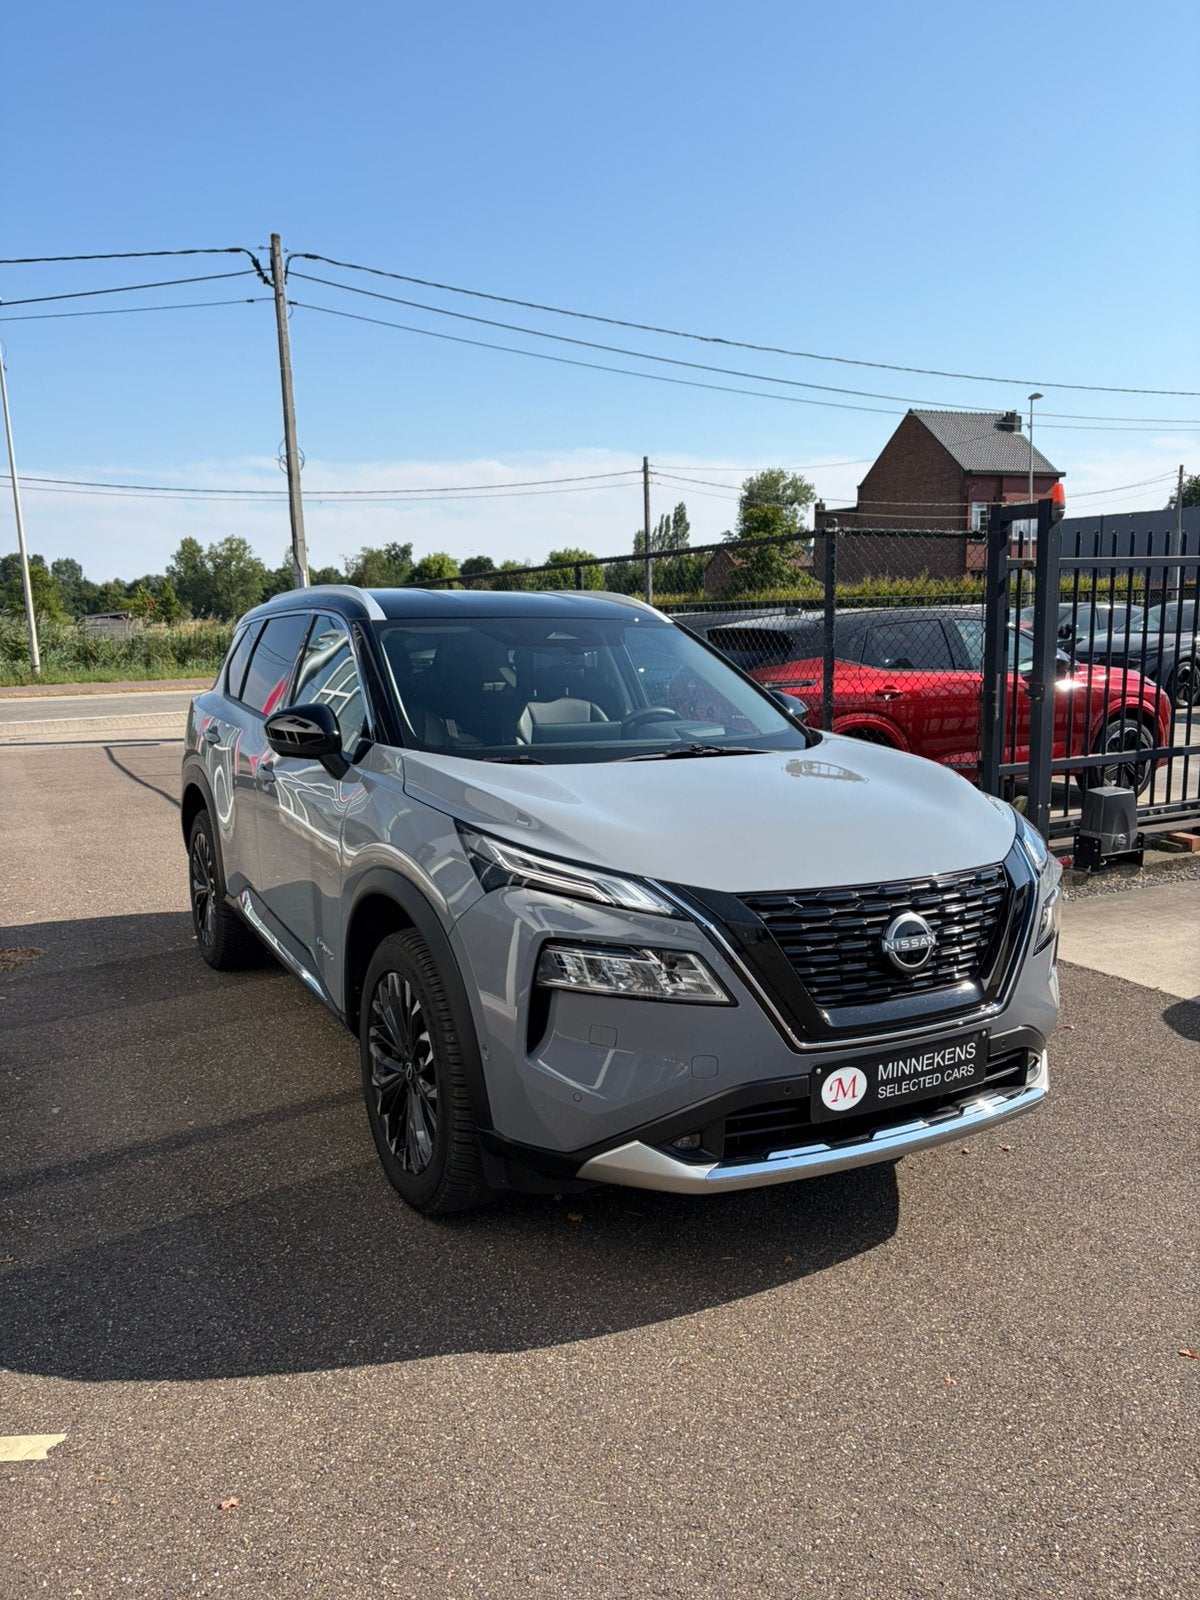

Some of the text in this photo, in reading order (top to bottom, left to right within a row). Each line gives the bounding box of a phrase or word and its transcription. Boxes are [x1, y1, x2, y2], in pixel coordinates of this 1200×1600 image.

[884, 935, 936, 950] NISSAN
[878, 1042, 976, 1081] MINNEKENS
[829, 1074, 858, 1103] M
[878, 1064, 975, 1099] SELECTED CARS
